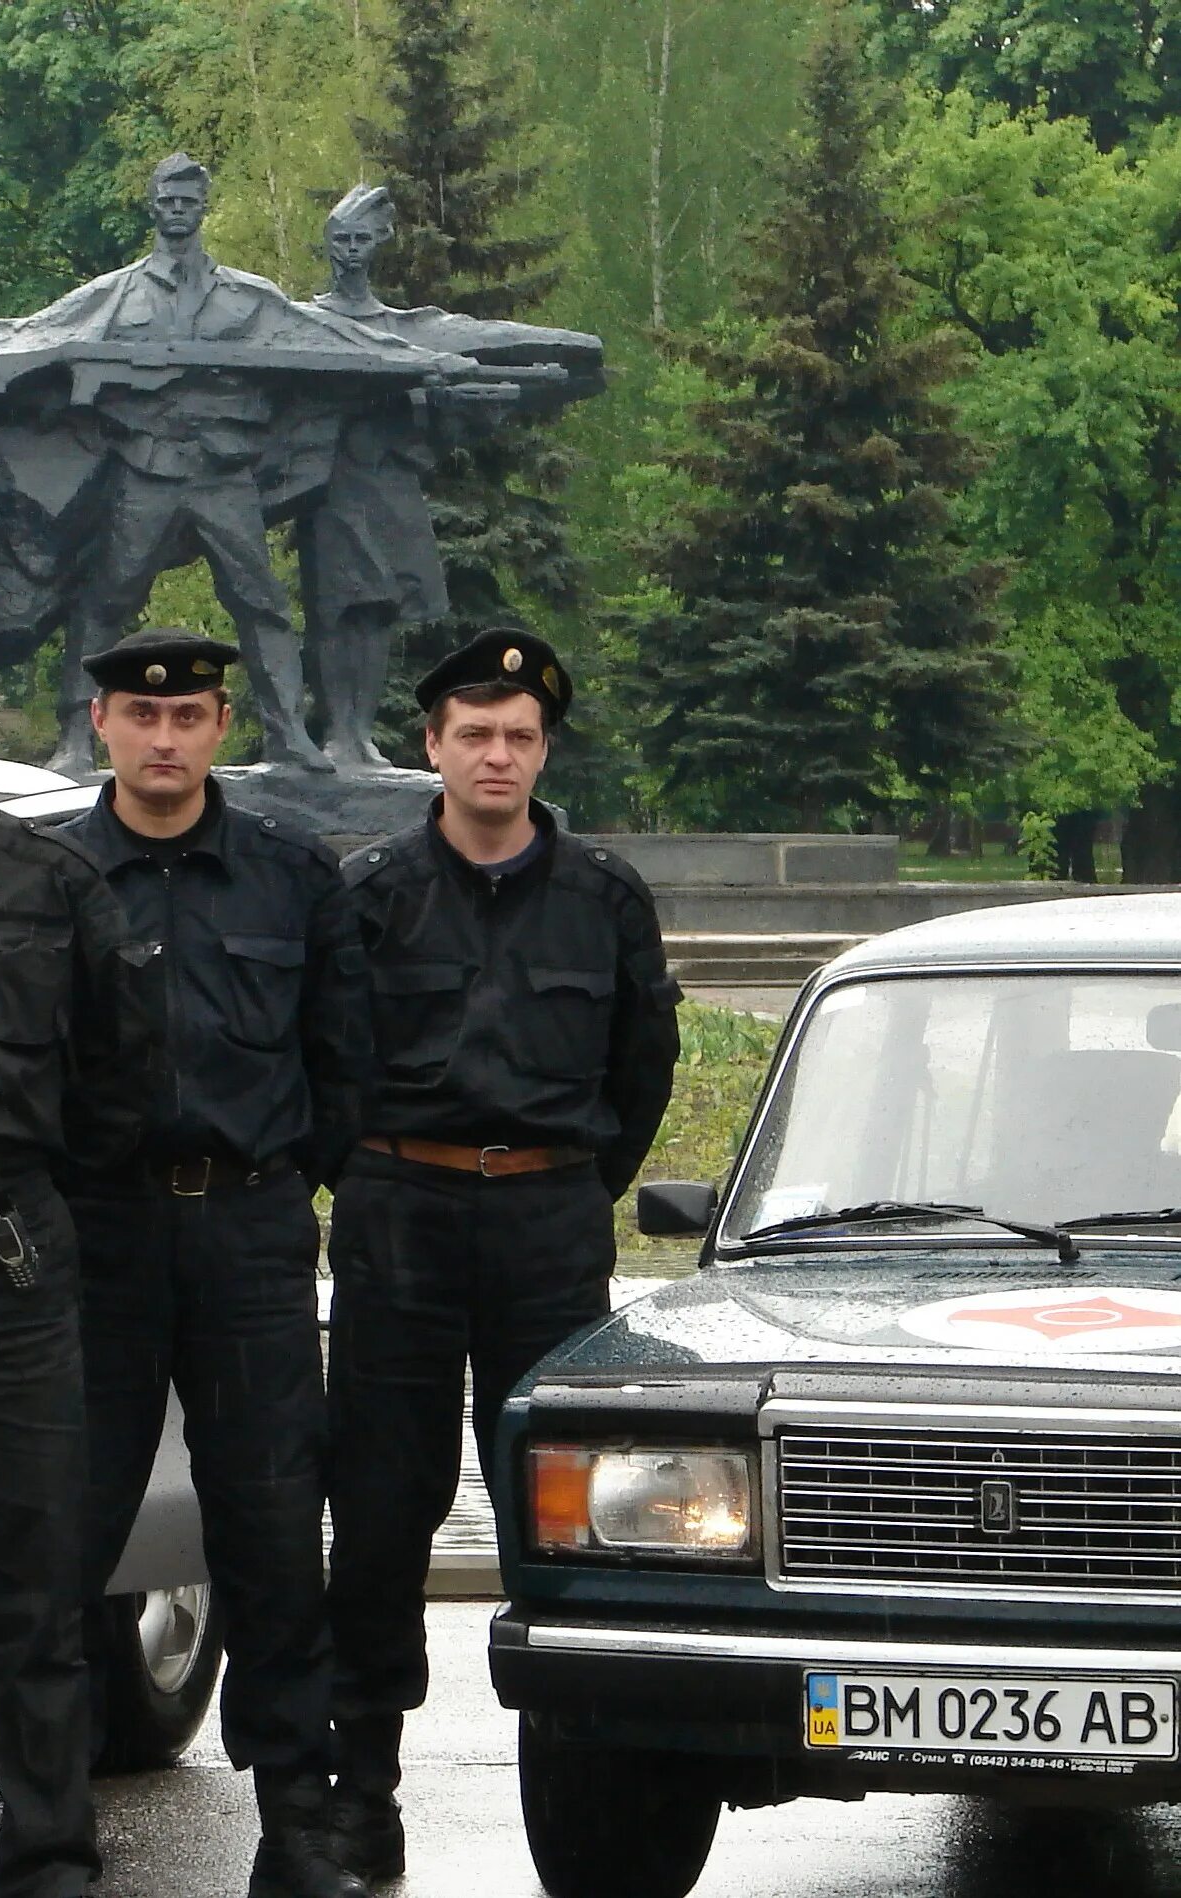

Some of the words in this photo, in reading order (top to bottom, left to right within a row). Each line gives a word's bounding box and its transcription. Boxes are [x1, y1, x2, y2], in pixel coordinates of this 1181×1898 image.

[844, 1685, 920, 1738] BM
[938, 1687, 1061, 1742] 0236
[1080, 1691, 1157, 1745] AB
[814, 1721, 836, 1735] UA
[912, 1752, 946, 1764] Сумы
[969, 1754, 1007, 1767] (0542)
